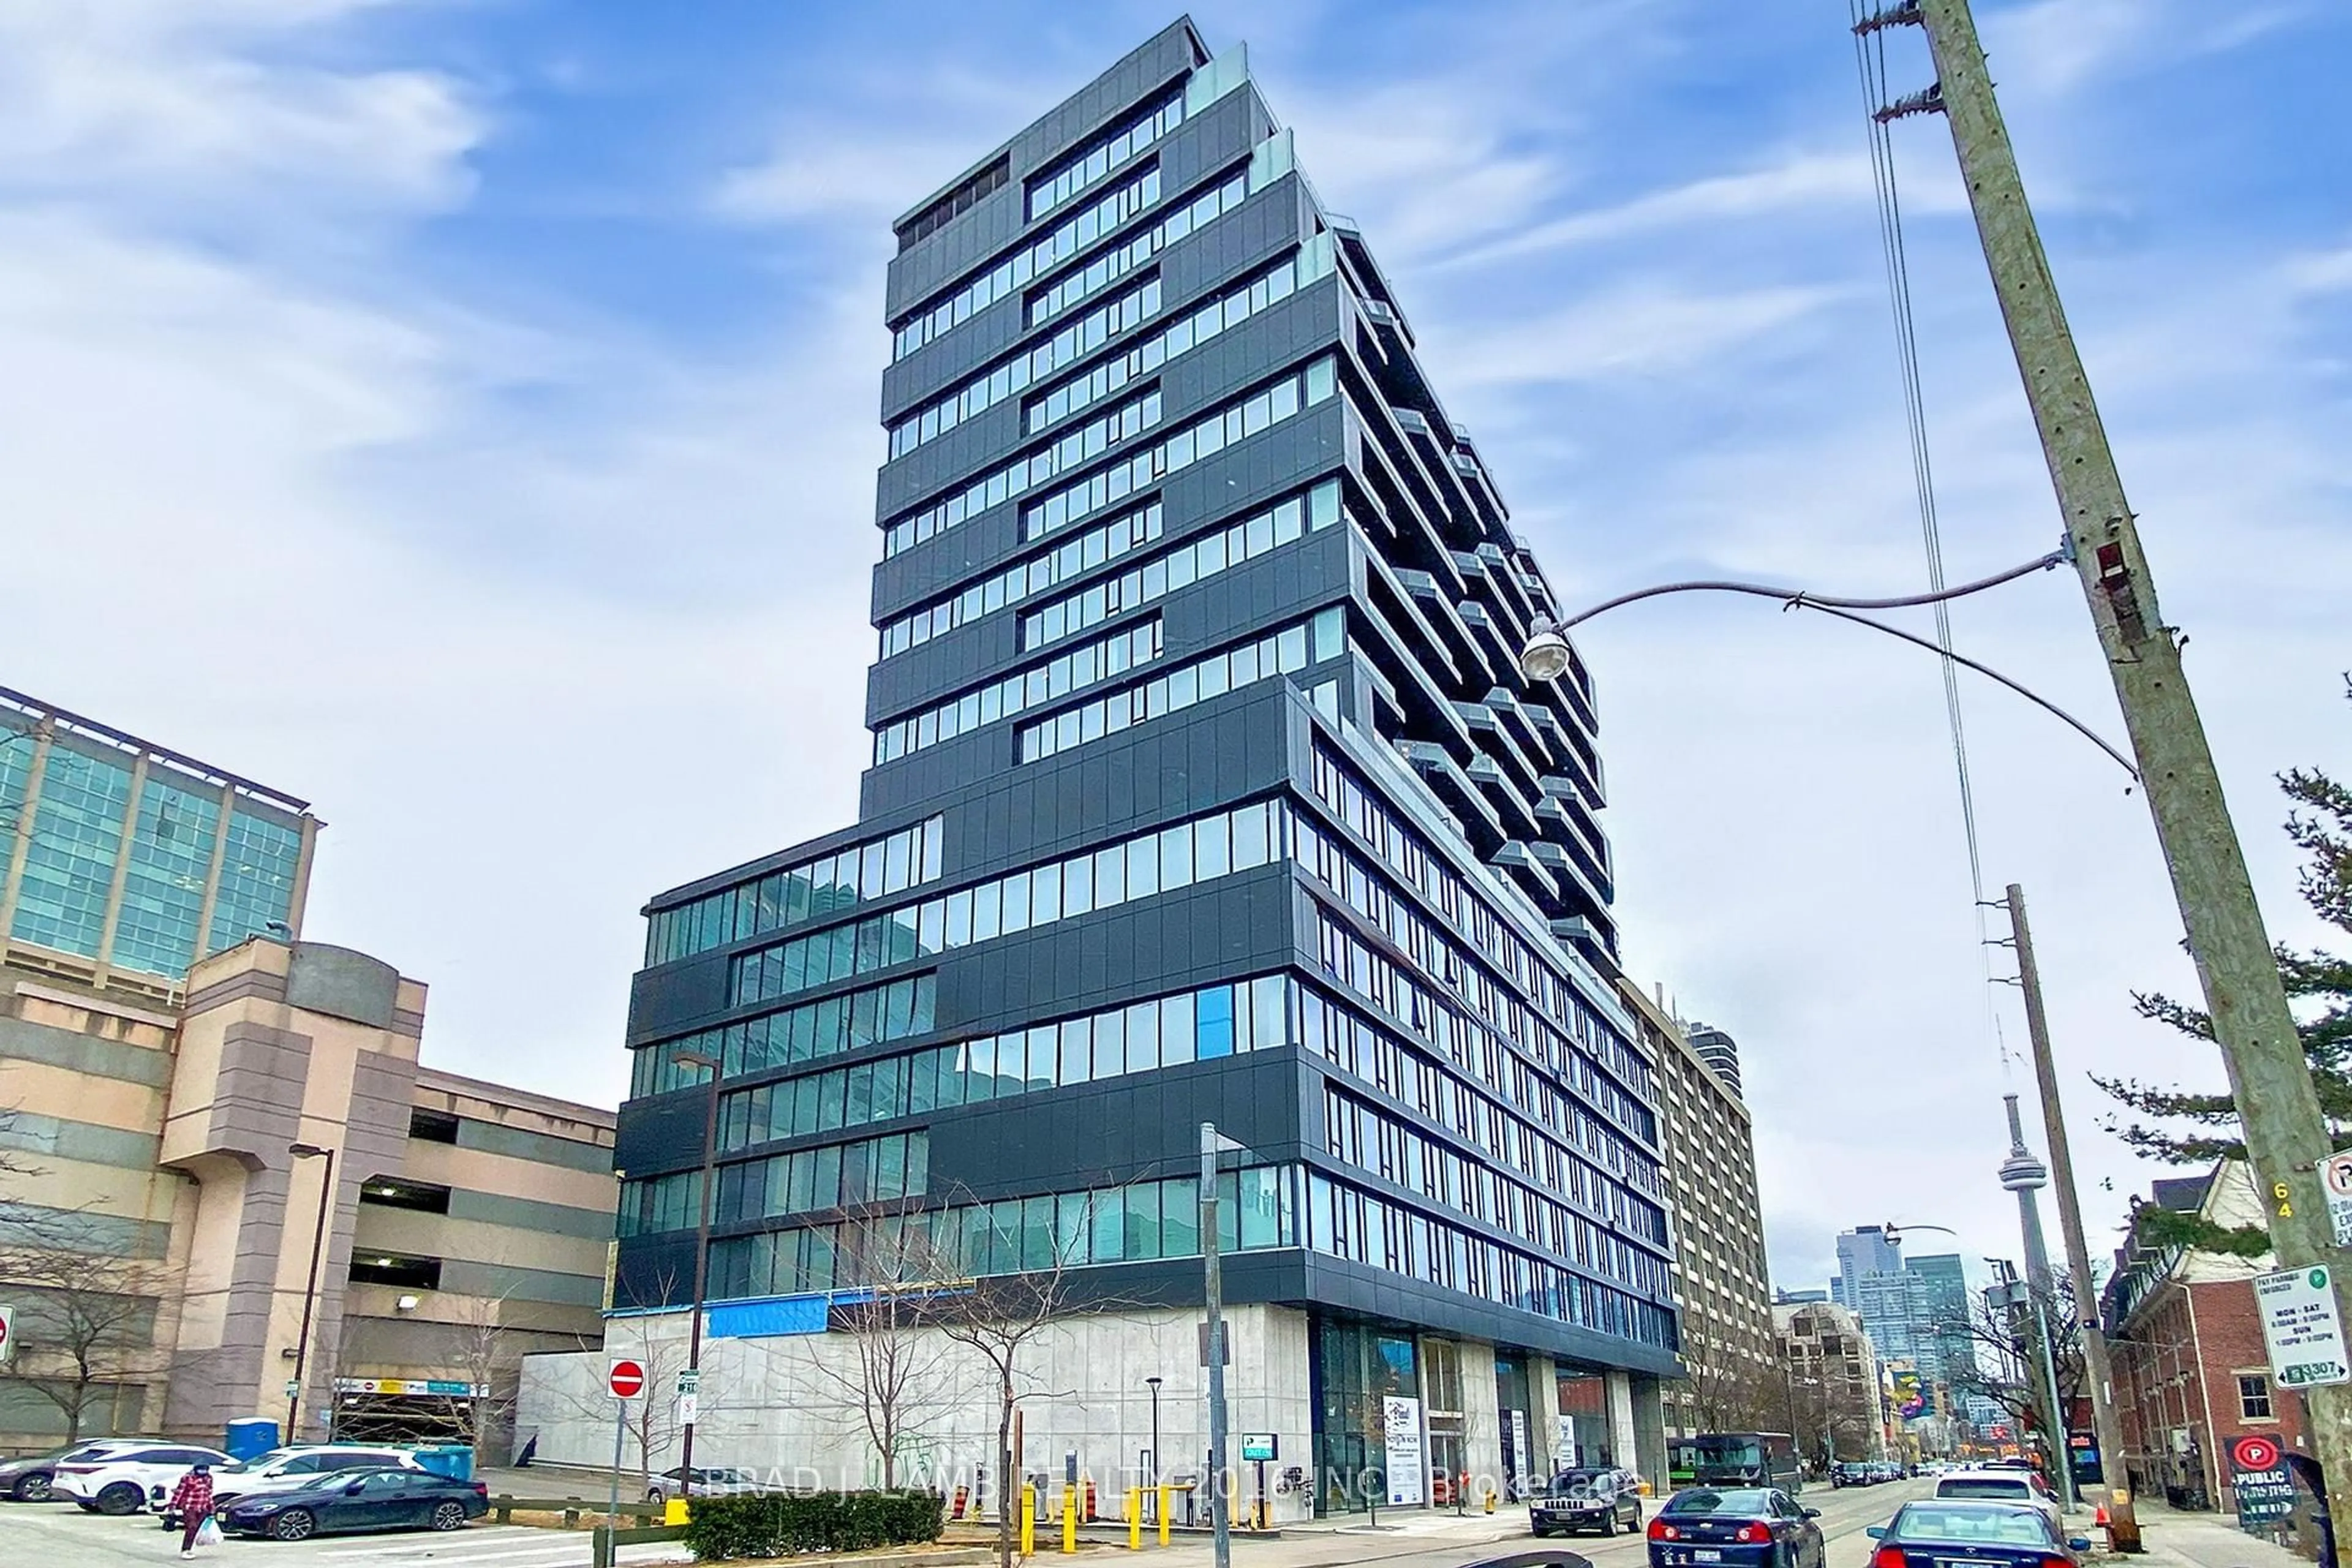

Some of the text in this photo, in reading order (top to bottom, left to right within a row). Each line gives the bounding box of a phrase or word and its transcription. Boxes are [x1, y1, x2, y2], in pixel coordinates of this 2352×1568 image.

[2275, 1183, 2288, 1199] 6
[2278, 1203, 2293, 1217] 4
[2304, 1303, 2320, 1313] SAT
[2250, 1449, 2262, 1460] P
[2237, 1471, 2285, 1485] PUBLIC
